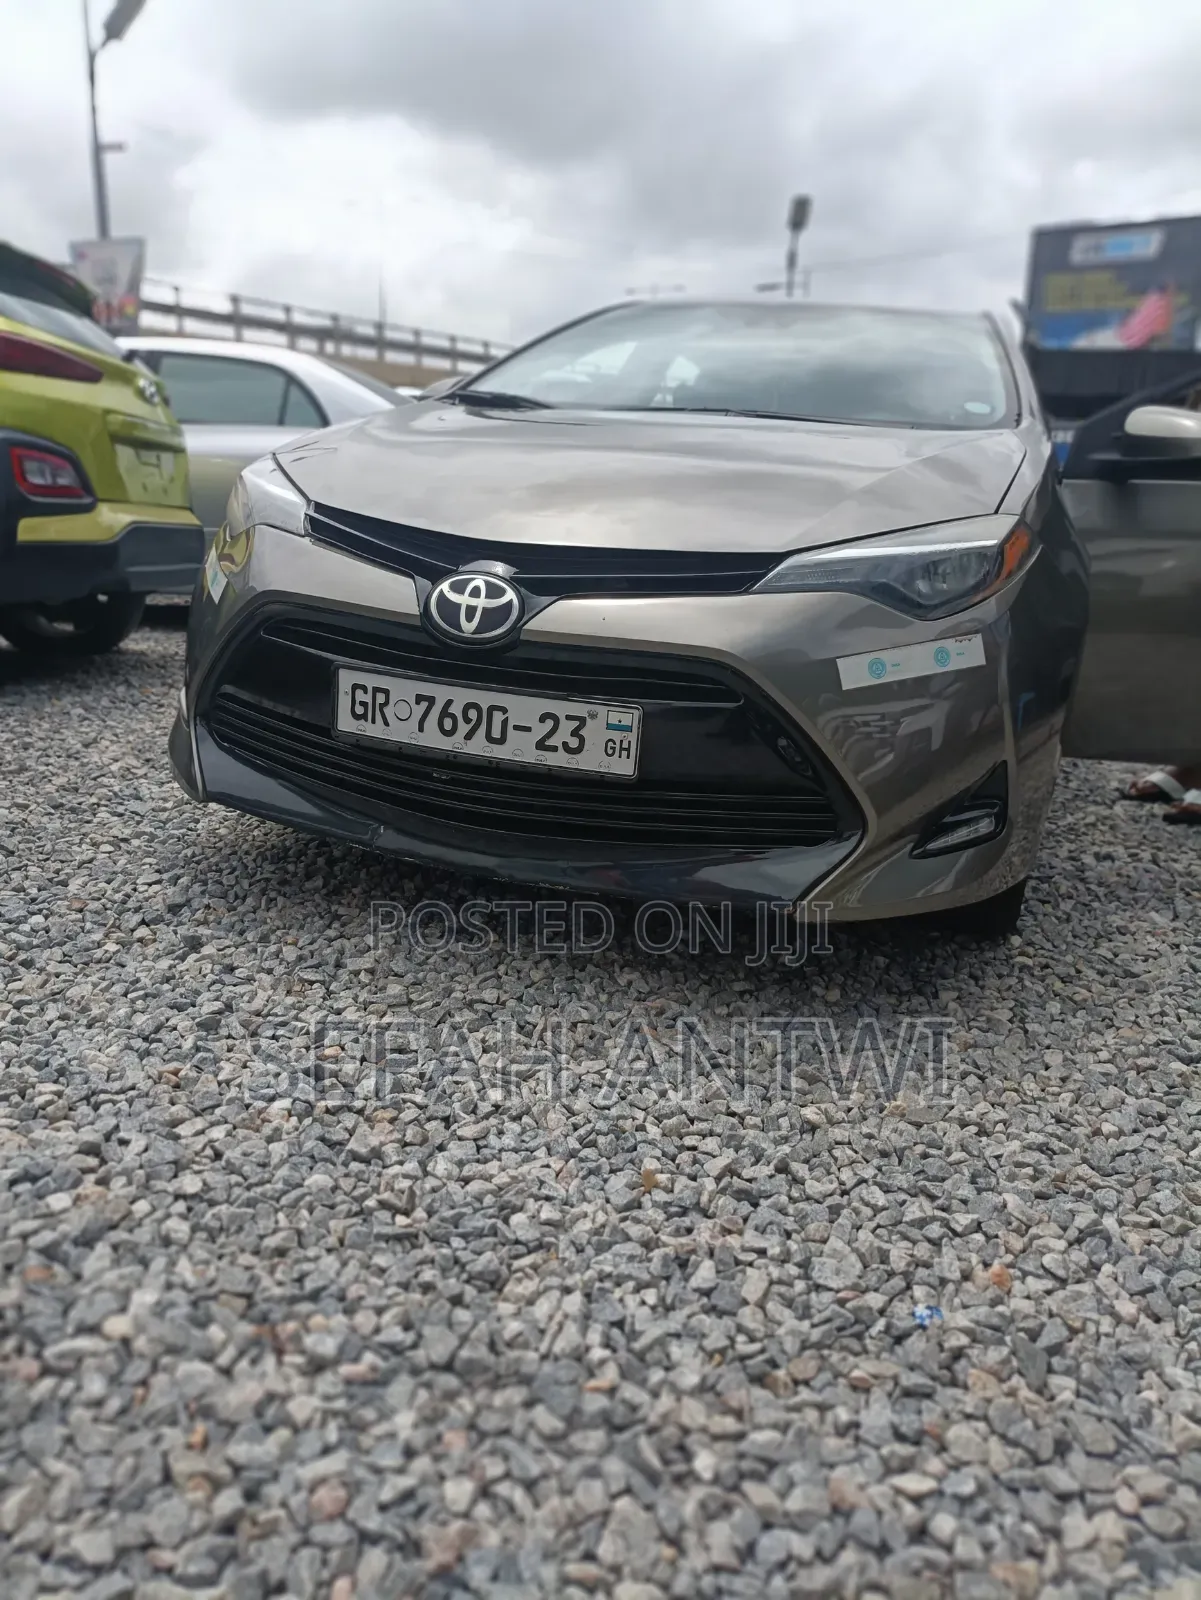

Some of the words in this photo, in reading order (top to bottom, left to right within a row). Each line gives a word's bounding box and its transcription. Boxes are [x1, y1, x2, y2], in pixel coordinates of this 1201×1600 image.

[350, 682, 391, 728] GR
[414, 693, 588, 755] 7690-23
[604, 738, 632, 760] GH
